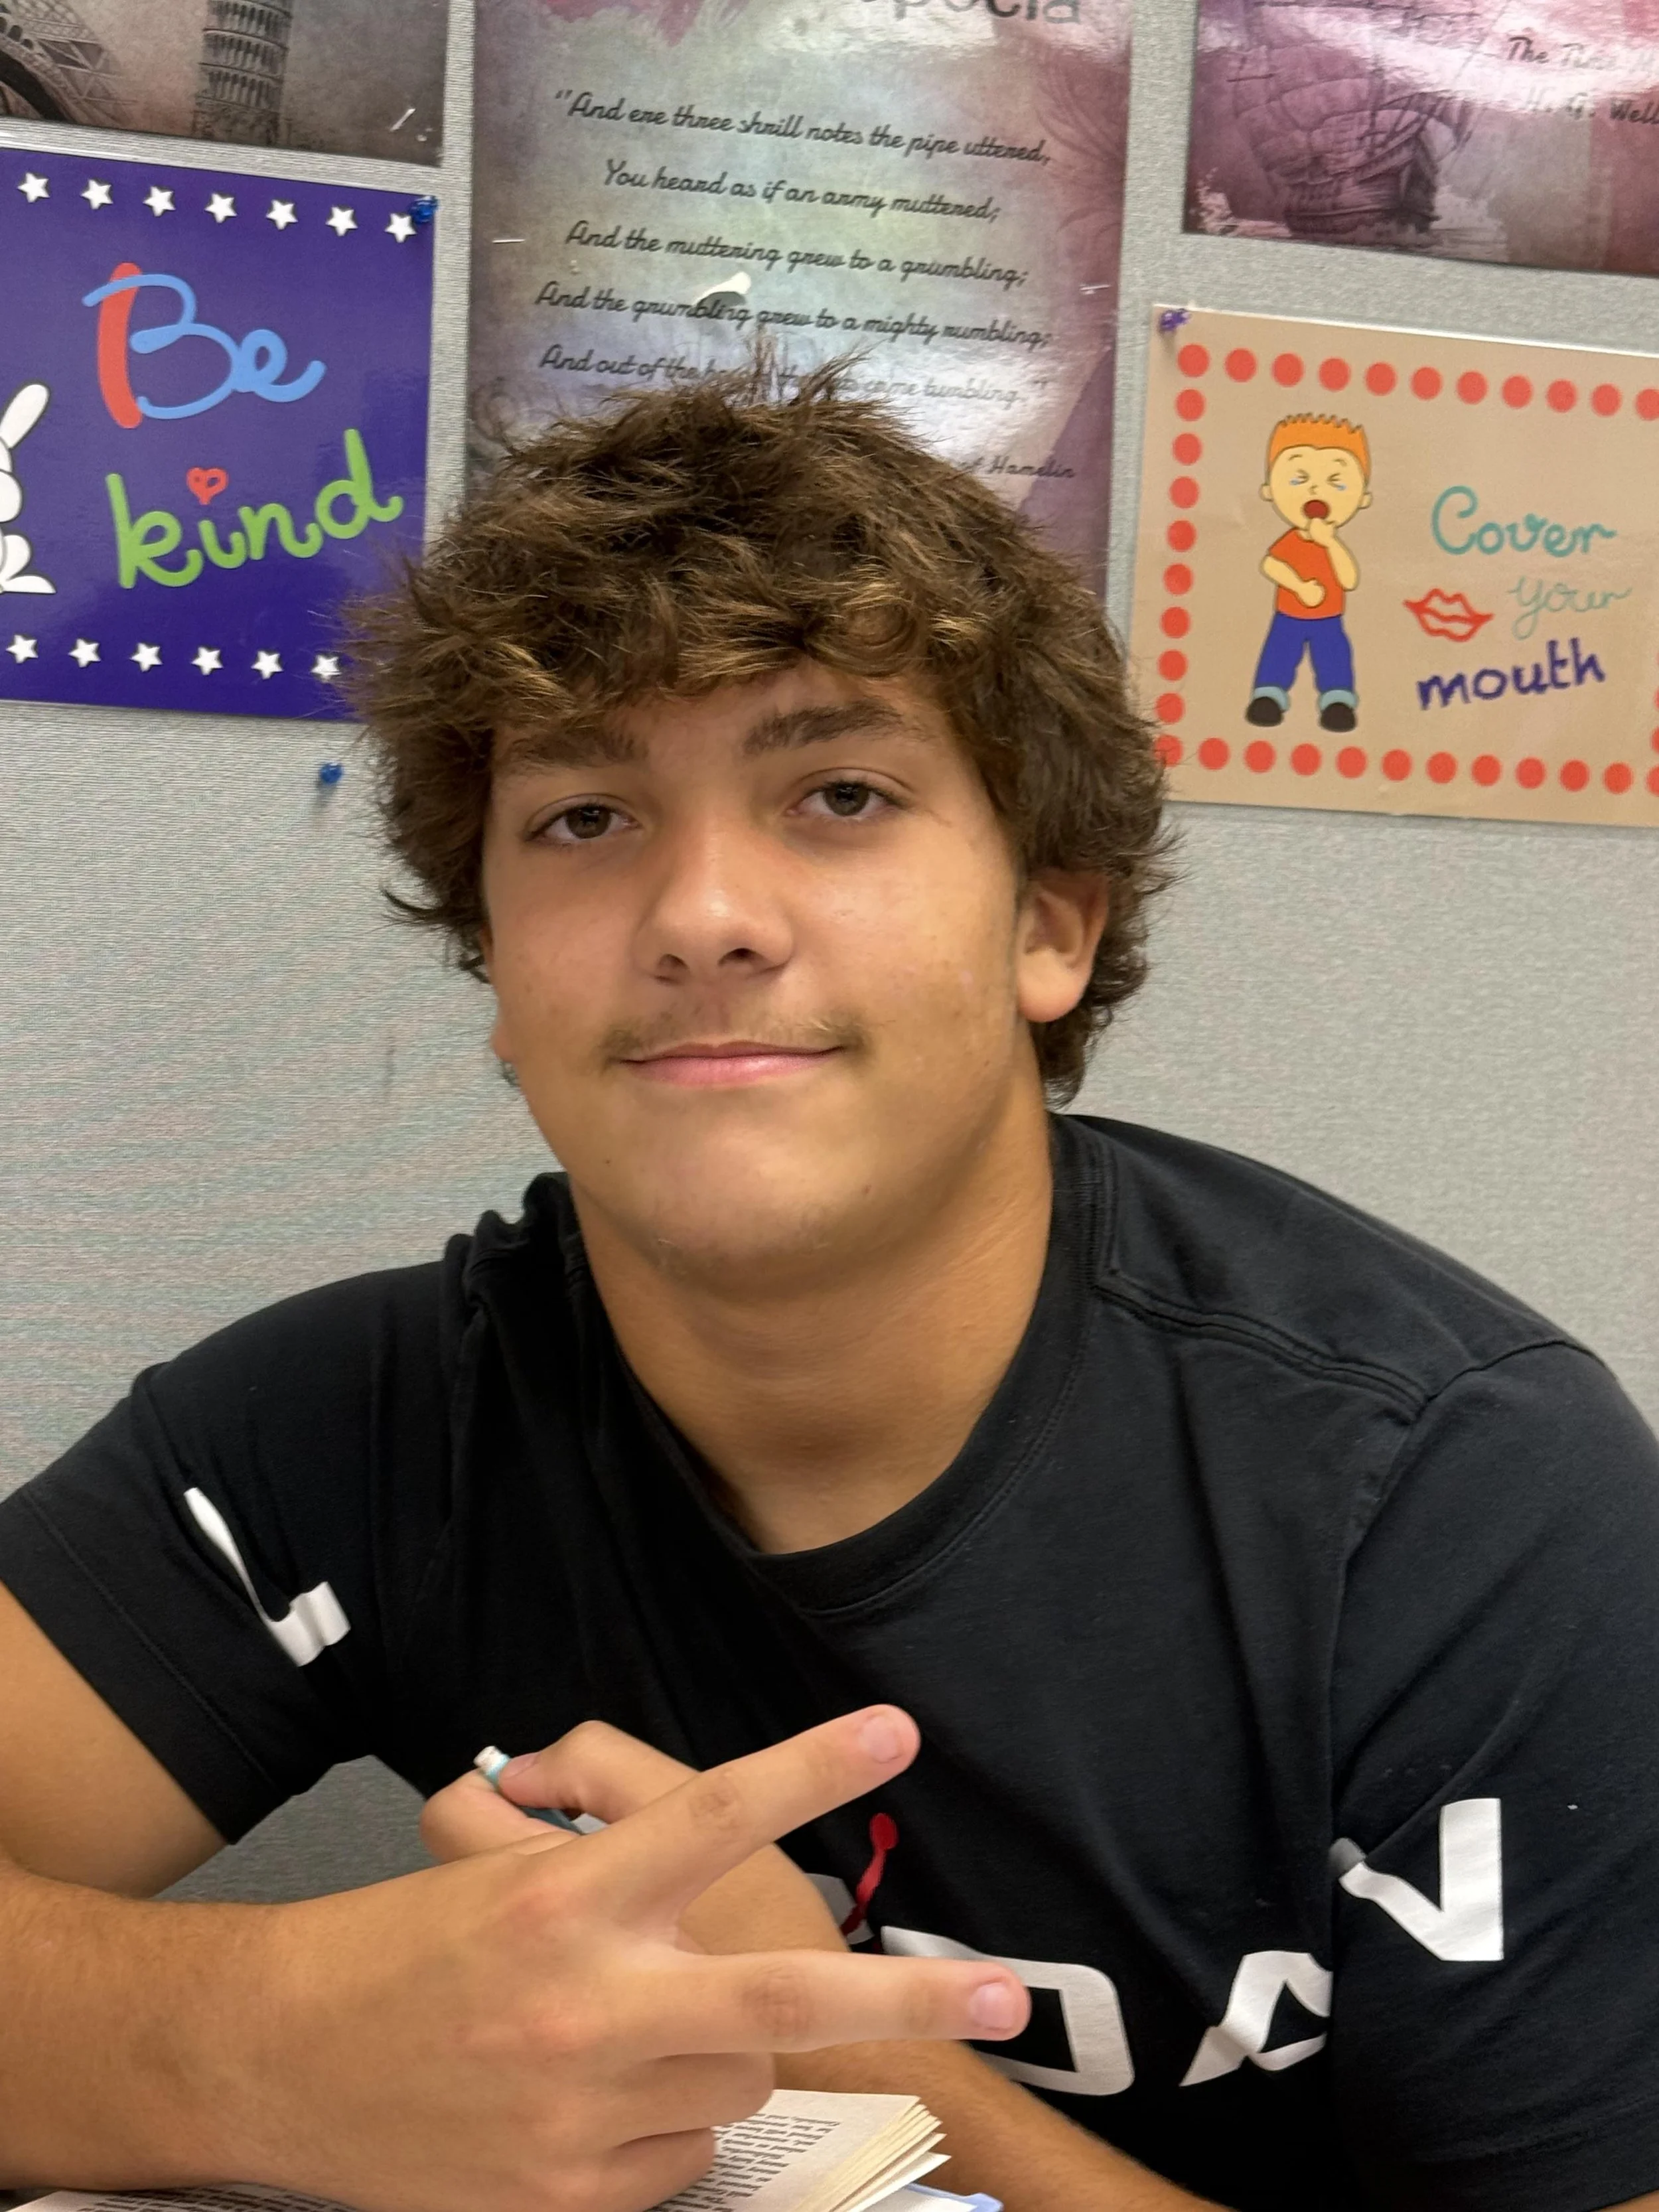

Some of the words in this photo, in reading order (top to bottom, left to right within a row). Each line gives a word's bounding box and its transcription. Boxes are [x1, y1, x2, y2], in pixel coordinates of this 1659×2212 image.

[1506, 36, 1550, 64] The
[629, 108, 669, 126] ere
[671, 104, 735, 132] three
[737, 110, 805, 139] shrill
[804, 122, 864, 145] notes
[869, 123, 905, 149] the
[903, 133, 960, 160] pipe
[603, 158, 649, 187] You
[650, 165, 729, 195] heard
[729, 181, 758, 198] as
[760, 179, 787, 205] if
[785, 185, 820, 204] an
[821, 188, 888, 218] army
[888, 193, 1002, 224] muttered;
[565, 219, 624, 249] And
[624, 226, 662, 252] the
[664, 236, 784, 271] muttering
[786, 249, 845, 273] grew
[847, 248, 875, 270] to
[877, 257, 896, 272] a
[900, 256, 1030, 291] grumbling;
[82, 261, 326, 429] Be
[534, 280, 592, 309] And
[591, 287, 628, 312] the
[631, 297, 755, 331] grumbling
[755, 308, 814, 332] grew
[814, 307, 841, 329] to
[841, 317, 861, 331] a
[862, 312, 939, 345] mighty
[940, 319, 1052, 352] rumbling;
[538, 343, 595, 372] And
[595, 354, 637, 376] out
[636, 356, 666, 383] of
[664, 356, 700, 380] the
[104, 428, 404, 589] kind
[1430, 484, 1619, 558] Cover
[1507, 575, 1634, 641] your
[1416, 636, 1607, 711] mouth
